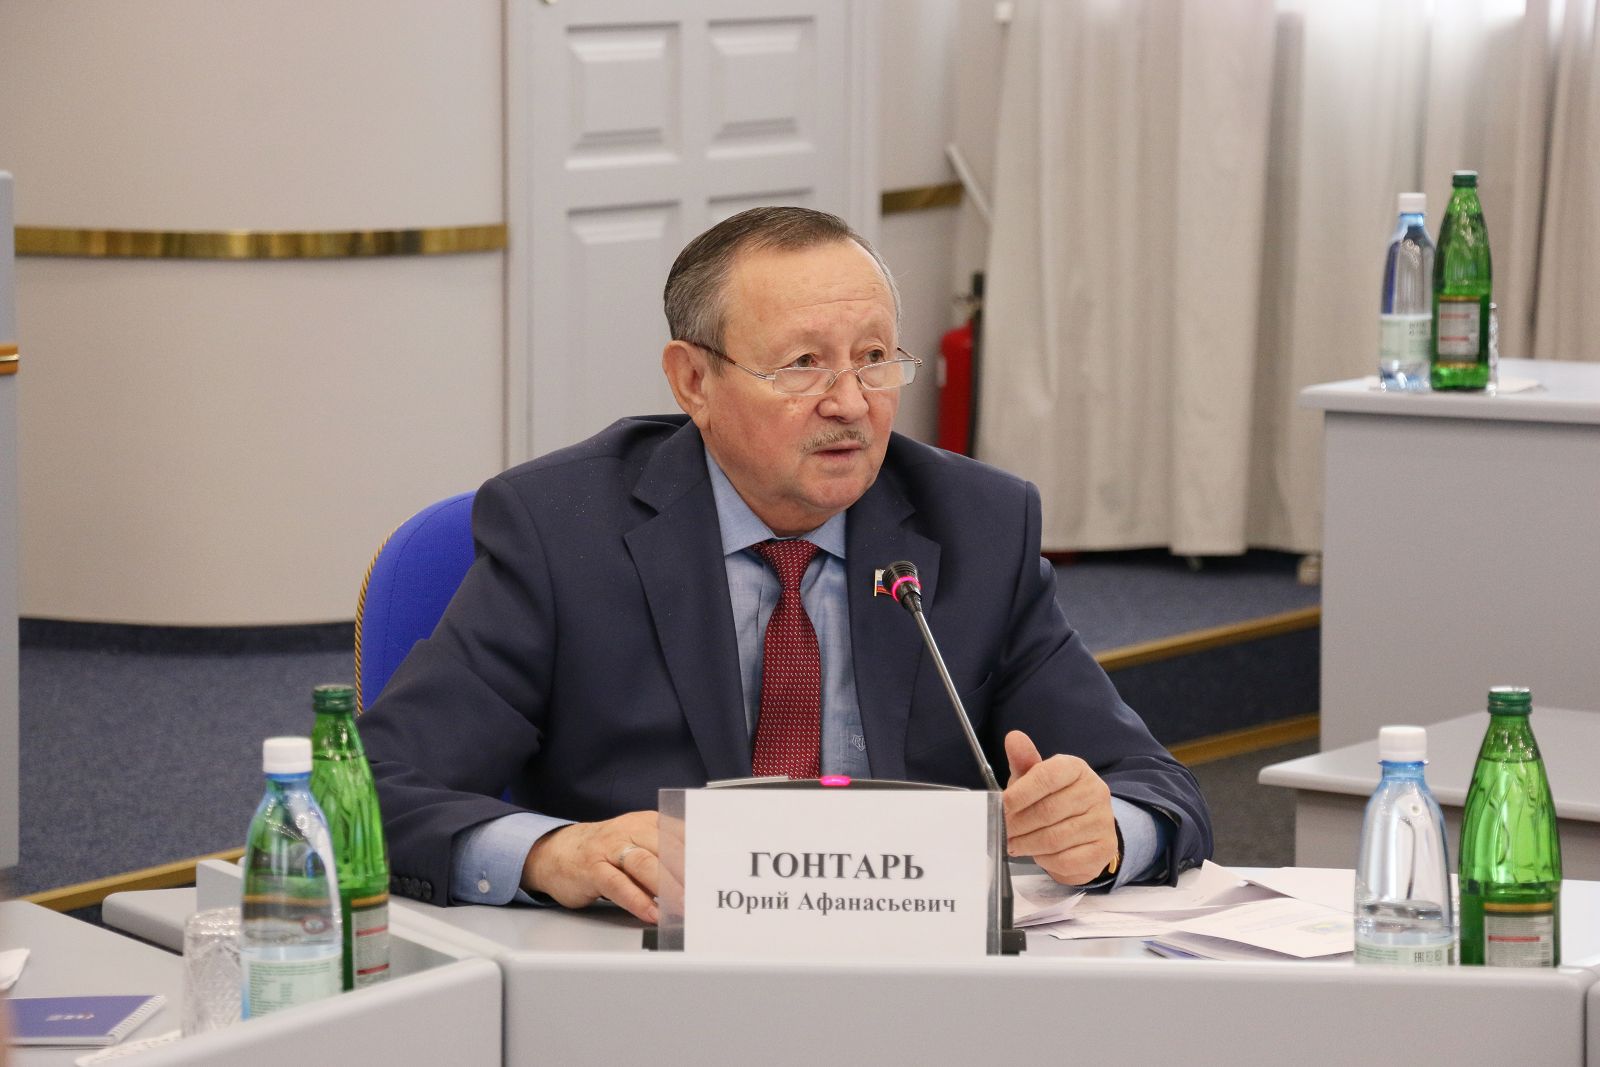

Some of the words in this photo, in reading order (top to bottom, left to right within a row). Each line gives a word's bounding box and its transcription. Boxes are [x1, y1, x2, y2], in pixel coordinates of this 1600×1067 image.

[749, 851, 925, 880] ГОНТАРЬ
[717, 890, 789, 914] Юрий
[797, 892, 956, 916] Афанасьевич
